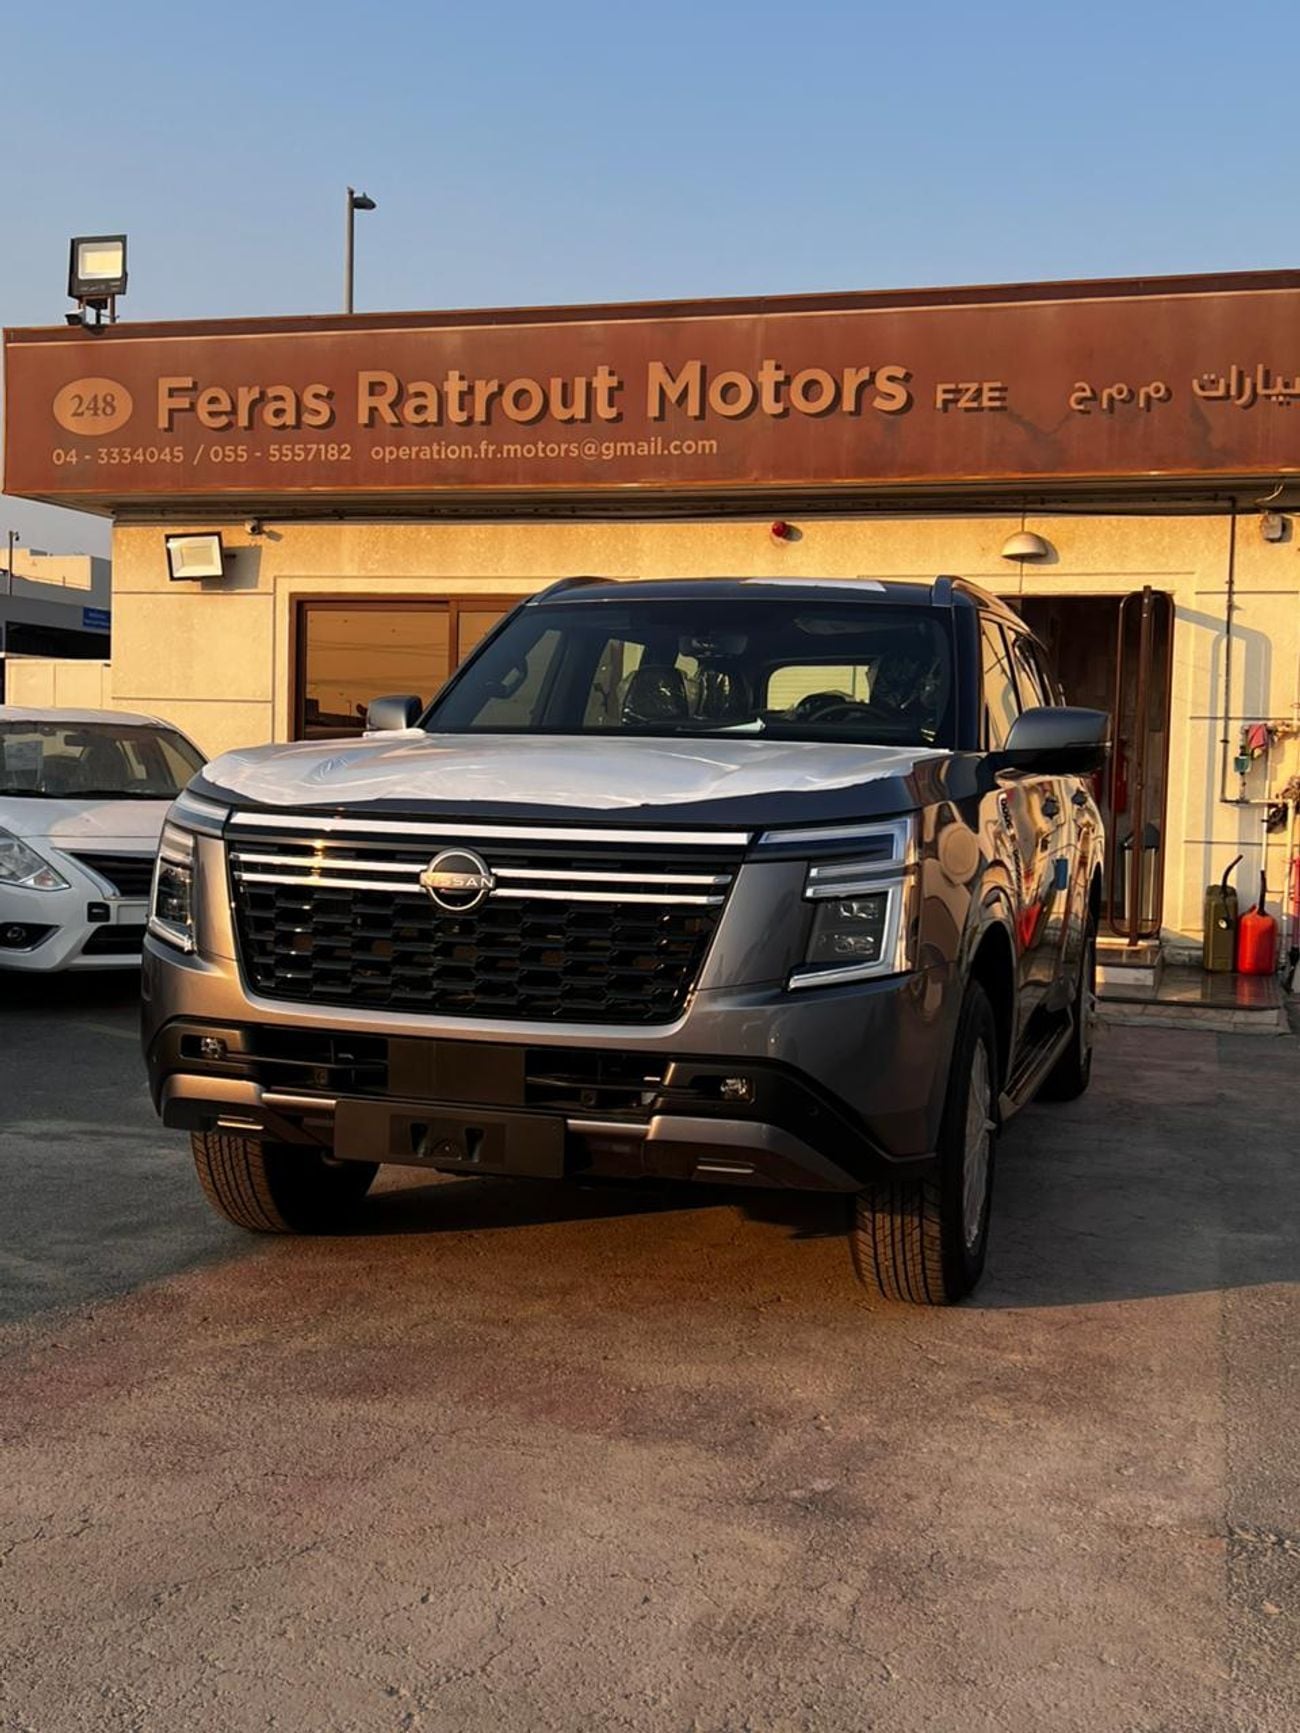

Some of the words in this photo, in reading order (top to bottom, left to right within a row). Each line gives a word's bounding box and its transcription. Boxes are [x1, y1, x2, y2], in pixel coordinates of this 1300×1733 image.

[157, 376, 333, 430] Feras
[357, 366, 620, 425] Ratrout
[647, 359, 909, 419] Motors
[935, 381, 1003, 409] FZE
[1192, 363, 1300, 405] يارات
[70, 392, 117, 418] 248
[52, 448, 78, 465] 04
[97, 446, 185, 465] 3334045
[209, 445, 248, 463] 055
[268, 443, 352, 462] 5557182
[370, 436, 719, 463] operation.fr.motors@gmail.com
